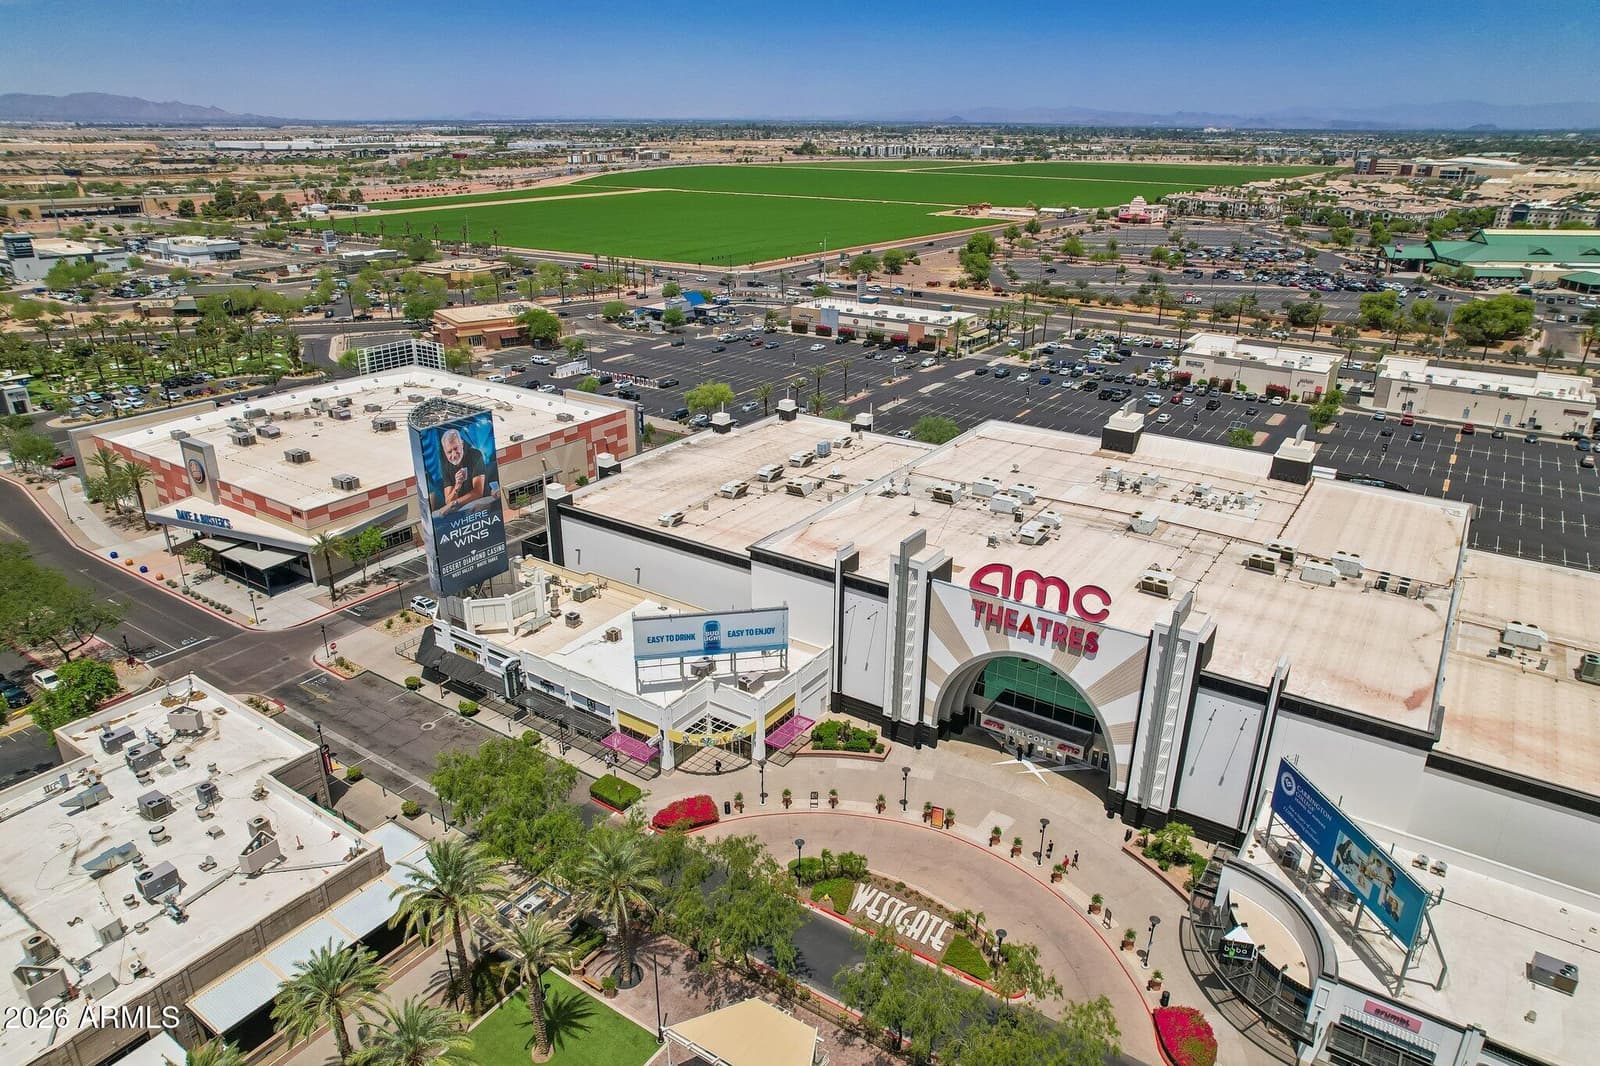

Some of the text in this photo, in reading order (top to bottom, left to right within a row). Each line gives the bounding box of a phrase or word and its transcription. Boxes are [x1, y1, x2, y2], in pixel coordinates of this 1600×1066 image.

[175, 509, 193, 521] DAVE
[450, 509, 489, 528] WHERE
[440, 515, 501, 544] ARIZONA
[454, 528, 489, 548] WINS
[442, 543, 506, 575] DESERT DIAMOND CASINO
[727, 626, 776, 638] EASY TO ENJOY
[971, 598, 1100, 655] THEATRES
[647, 632, 696, 644] EASY TO DRINK
[1008, 727, 1054, 746] WELCOME
[1296, 784, 1333, 822] CARRINGTON
[851, 882, 955, 952] WESTGATE
